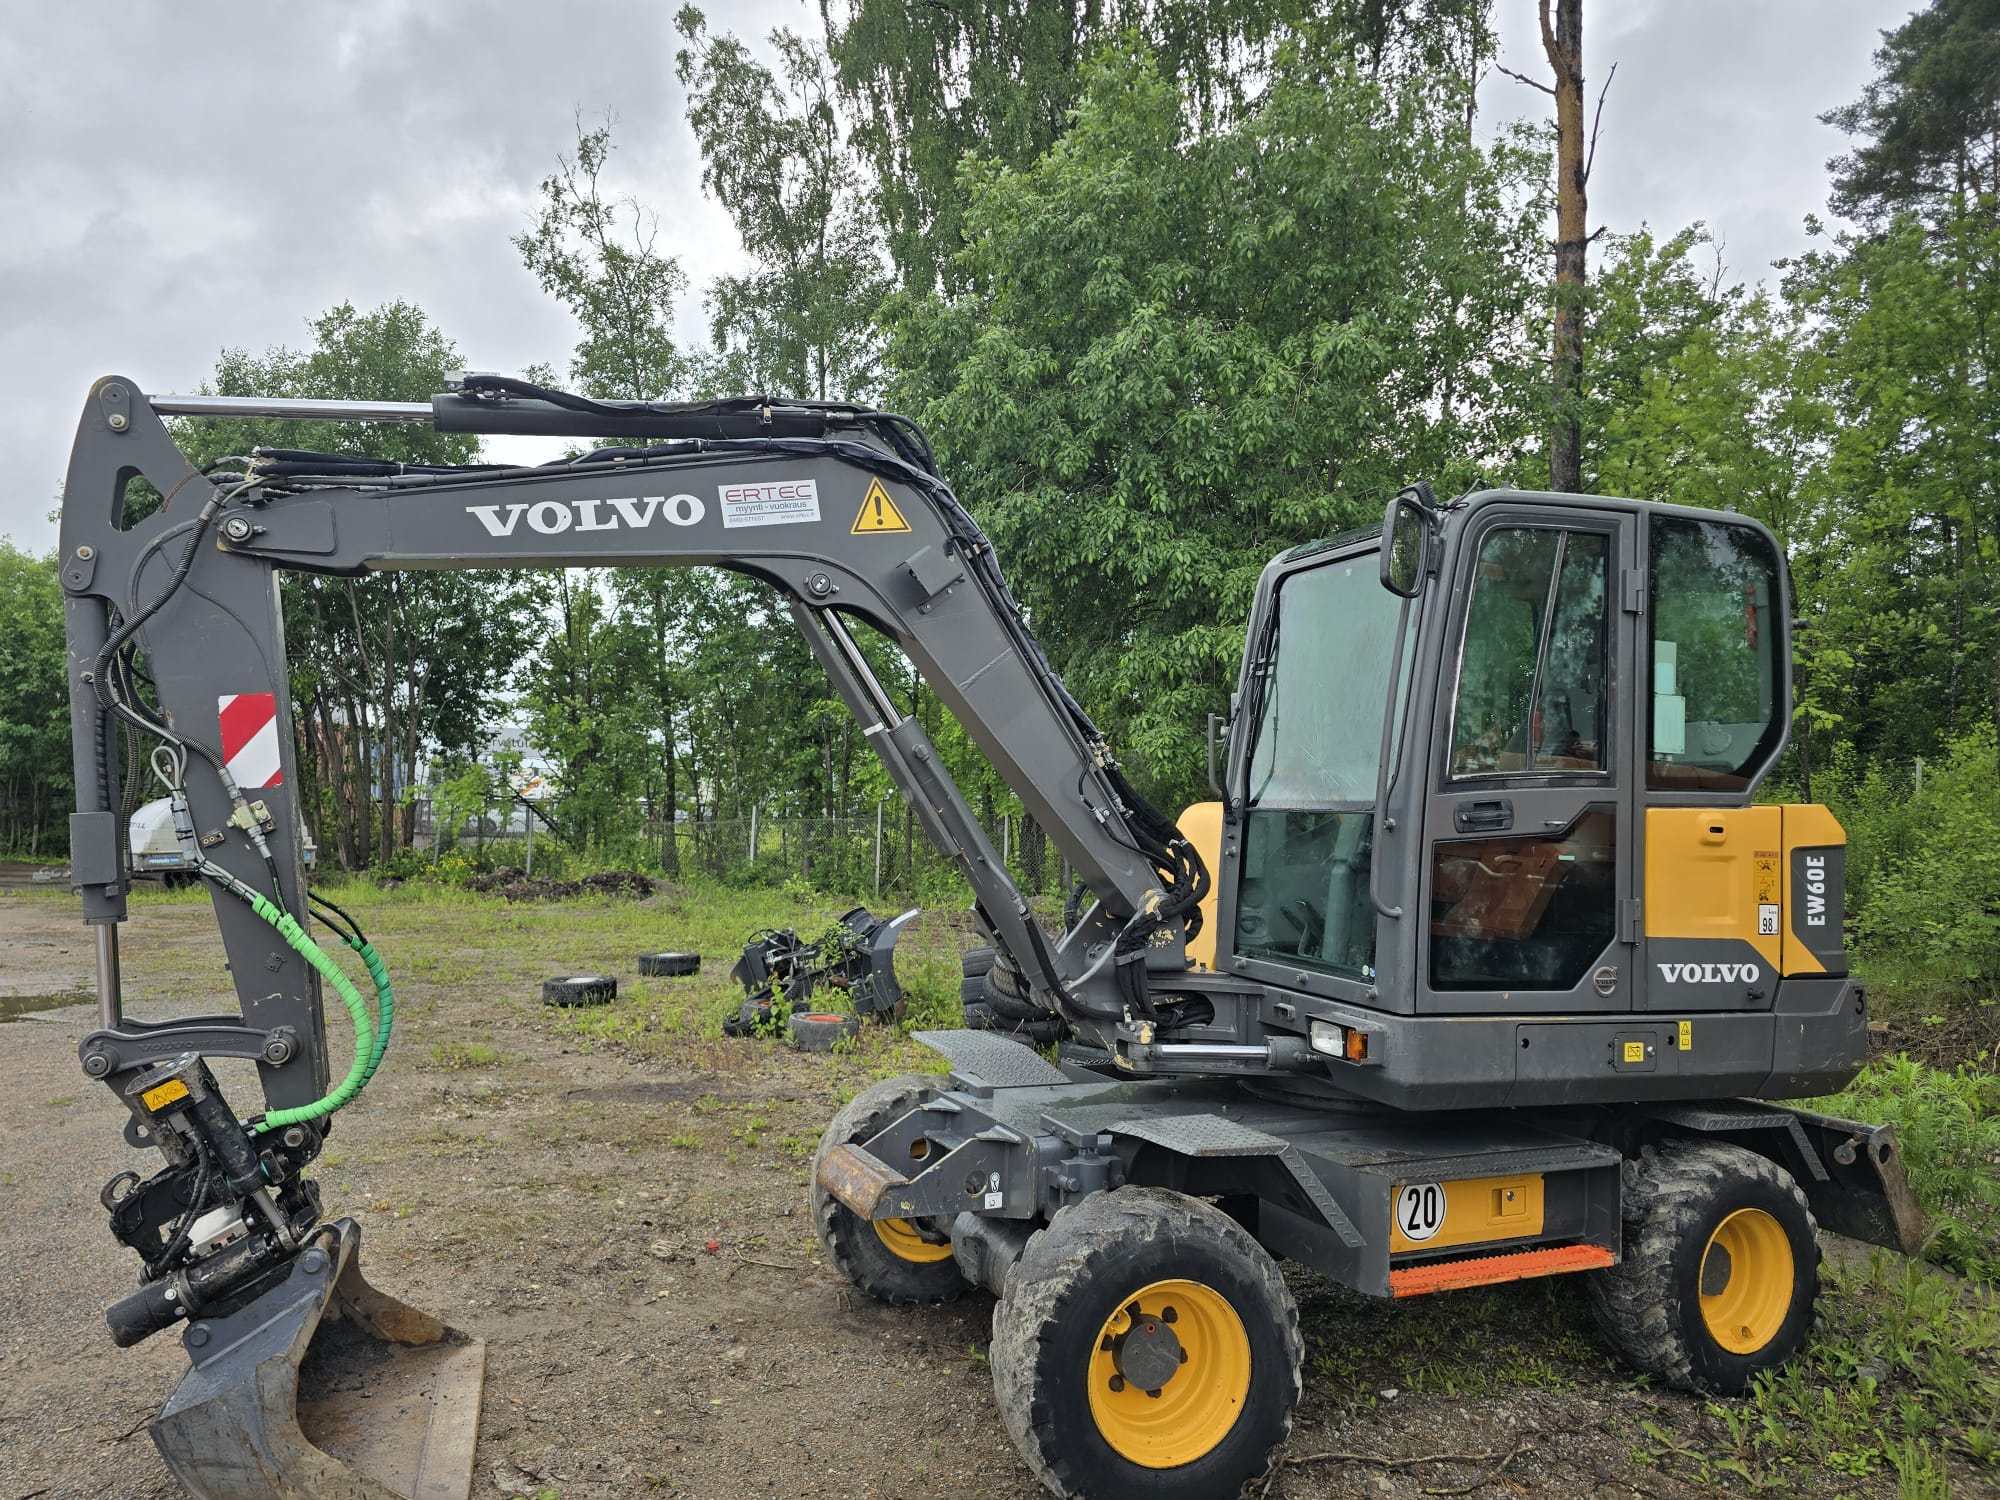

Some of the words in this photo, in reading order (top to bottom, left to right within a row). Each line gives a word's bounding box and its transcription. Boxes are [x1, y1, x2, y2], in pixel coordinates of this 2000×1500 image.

[726, 484, 813, 503] ERTEC
[465, 494, 706, 536] VOLVO
[769, 502, 807, 511] vuokraus
[1806, 856, 1826, 926] EW60E
[1762, 917, 1773, 932] 98
[1657, 963, 1760, 983] VOLVO
[1407, 1186, 1437, 1231] 20
